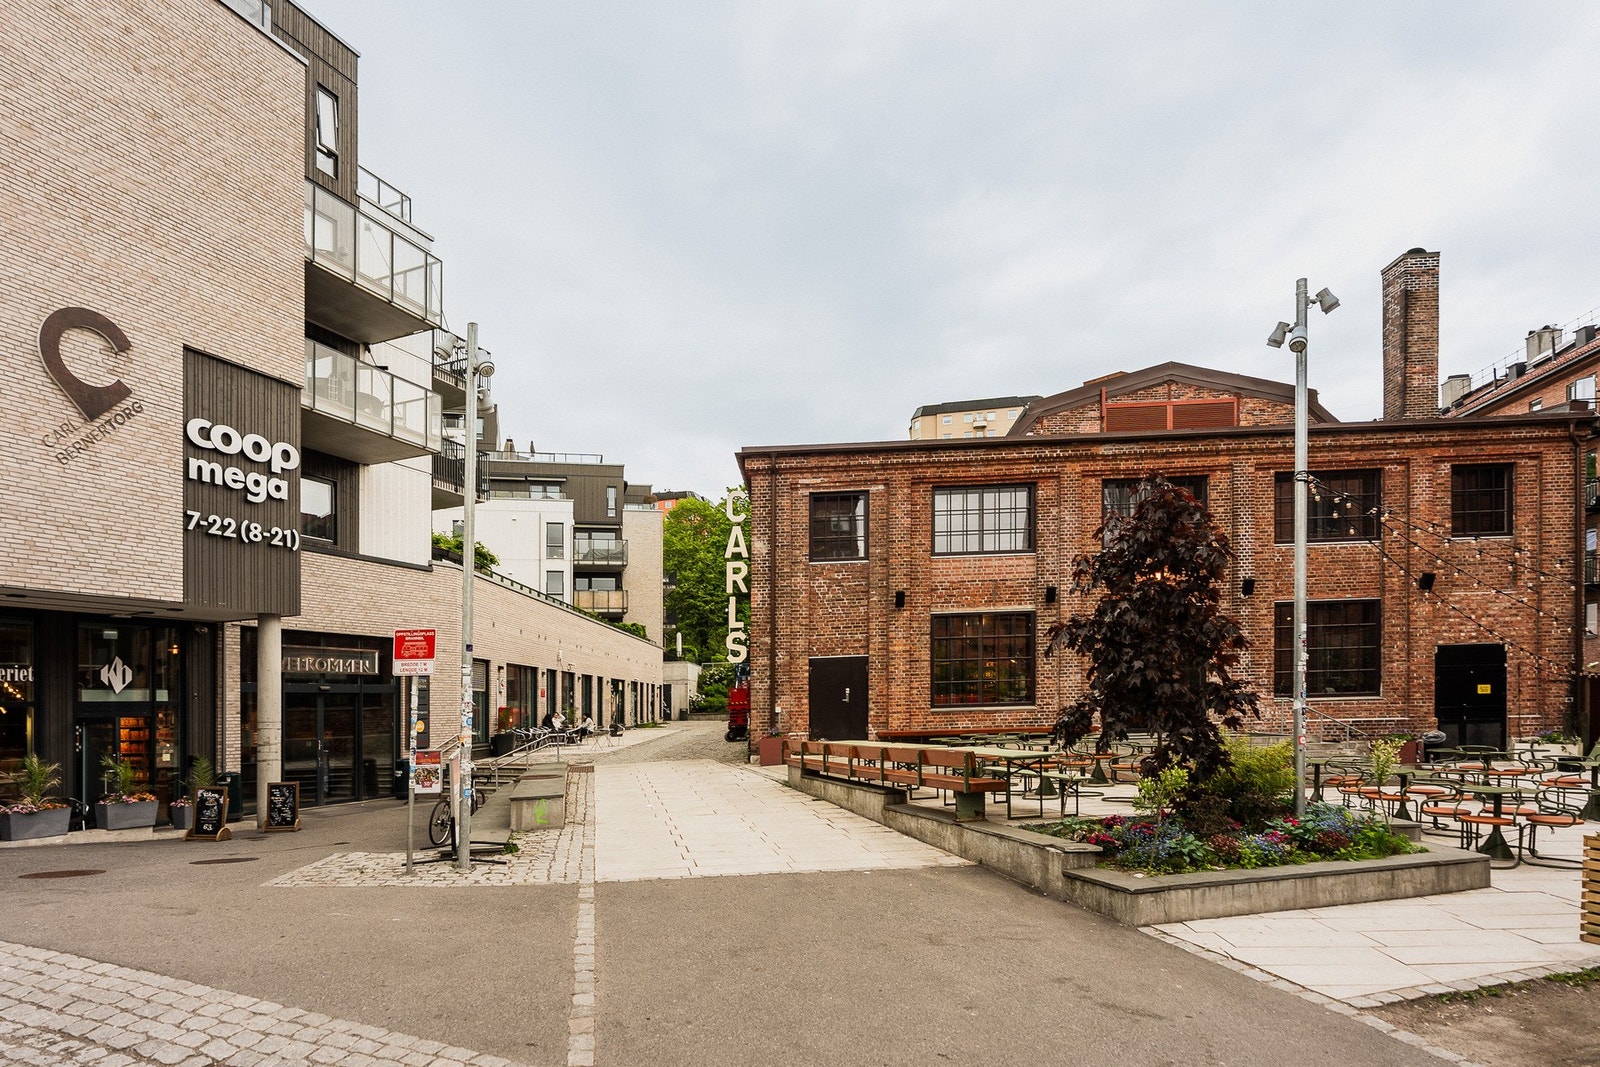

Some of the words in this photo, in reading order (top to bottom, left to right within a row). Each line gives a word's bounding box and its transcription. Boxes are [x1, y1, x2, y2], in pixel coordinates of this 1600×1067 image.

[42, 419, 83, 449] CARL
[186, 418, 300, 474] coop
[188, 457, 290, 503] mega
[187, 510, 237, 538] 7-22
[240, 519, 300, 552] (8-21)
[724, 490, 749, 664] CARLS
